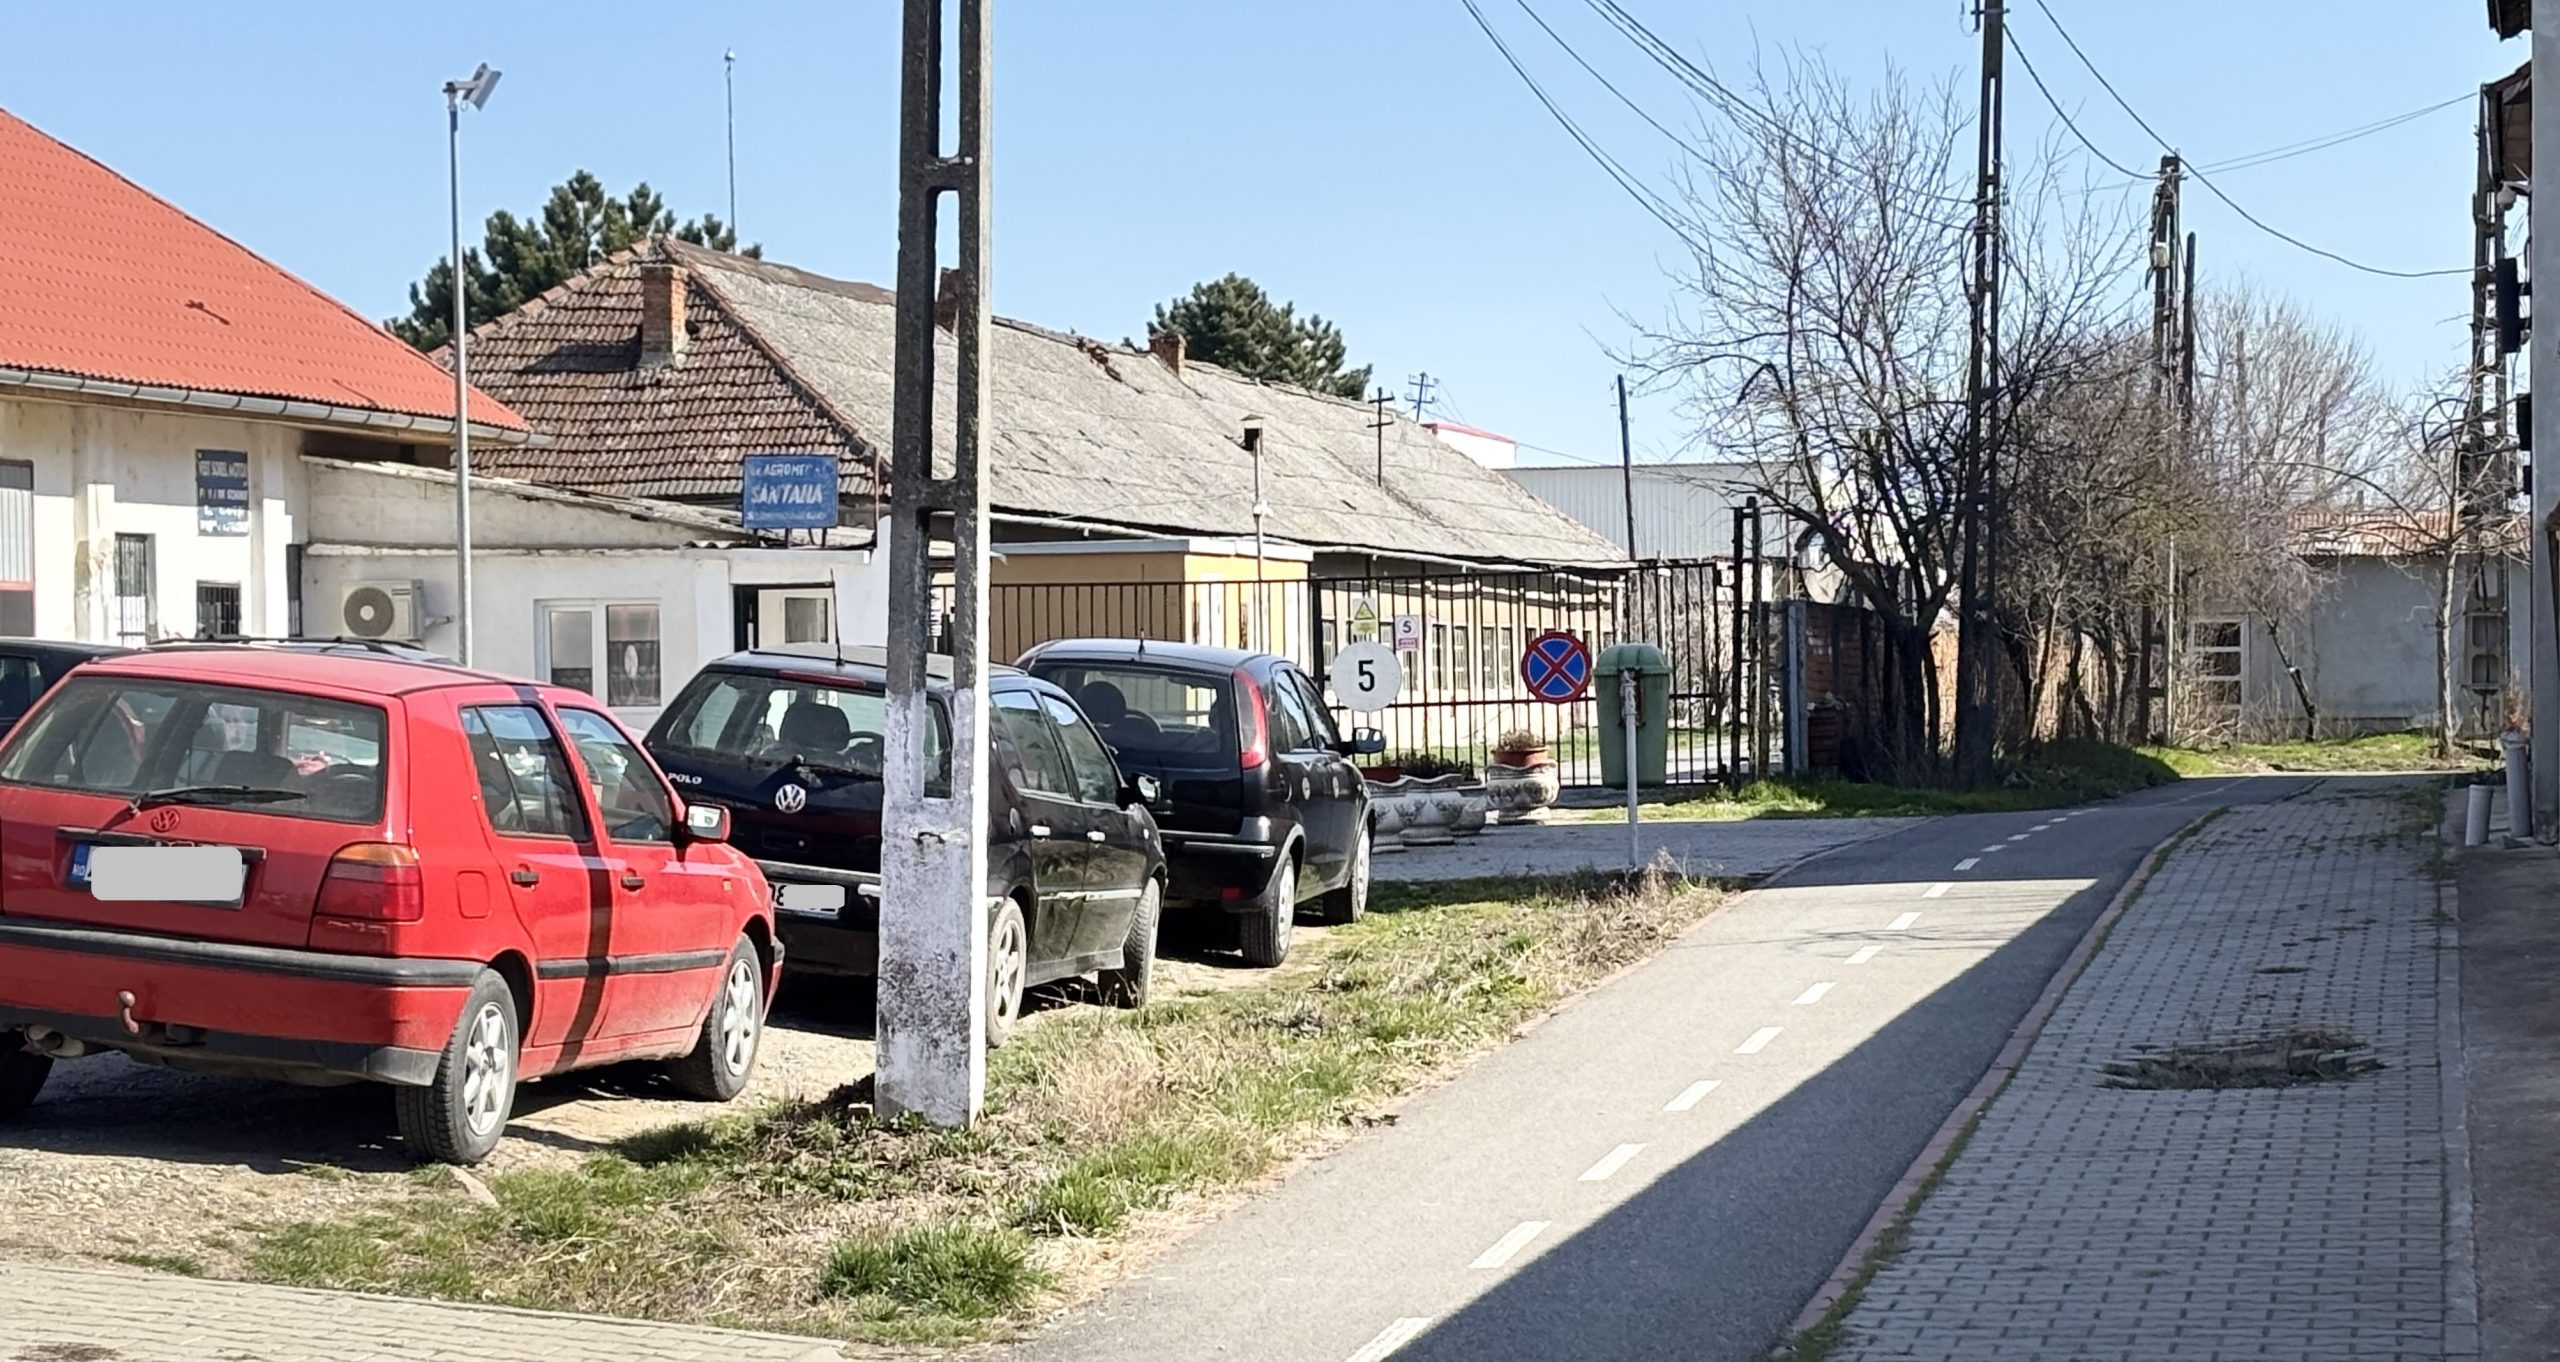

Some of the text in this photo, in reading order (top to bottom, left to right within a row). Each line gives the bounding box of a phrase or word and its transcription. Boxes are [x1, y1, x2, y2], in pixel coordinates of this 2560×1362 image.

[751, 483, 823, 504] SANTANA
[1402, 620, 1412, 633] 5
[1358, 659, 1375, 692] 5
[668, 772, 702, 785] POLO
